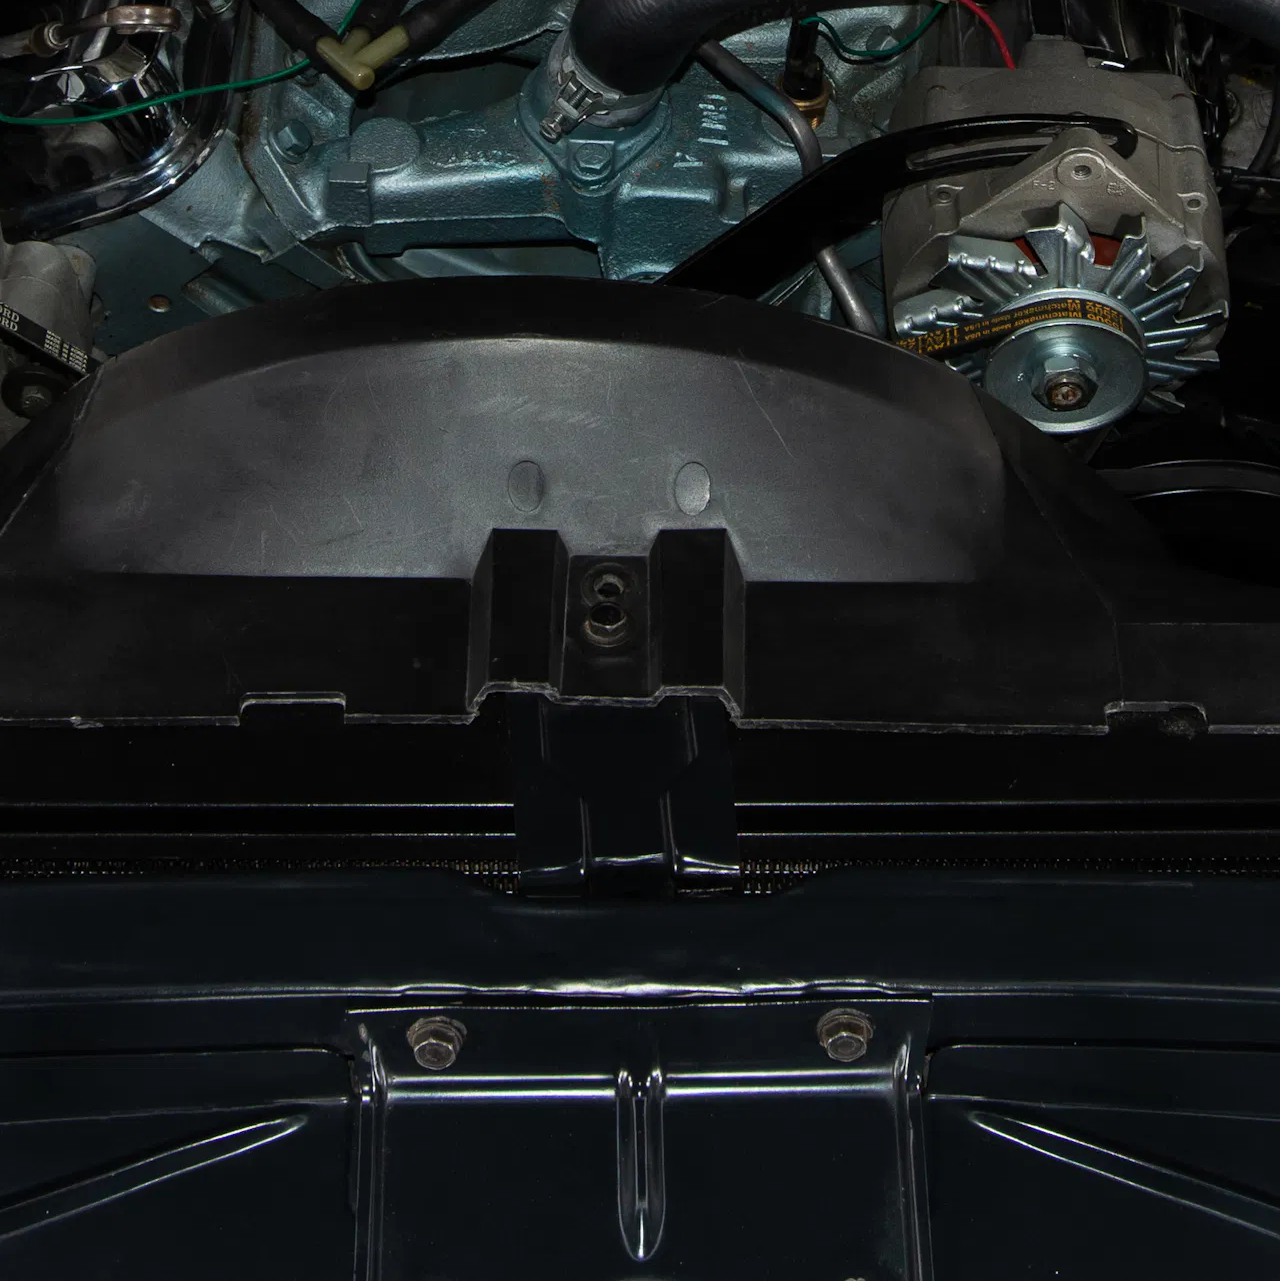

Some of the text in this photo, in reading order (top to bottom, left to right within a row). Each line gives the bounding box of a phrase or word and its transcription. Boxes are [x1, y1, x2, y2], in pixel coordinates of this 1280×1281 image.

[1013, 301, 1081, 317] Matchmaker
[991, 314, 1011, 323] Made
[1015, 312, 1082, 327] Matchmaker
[964, 323, 981, 332] USA
[991, 323, 1011, 332] Made
[964, 332, 981, 340] USA
